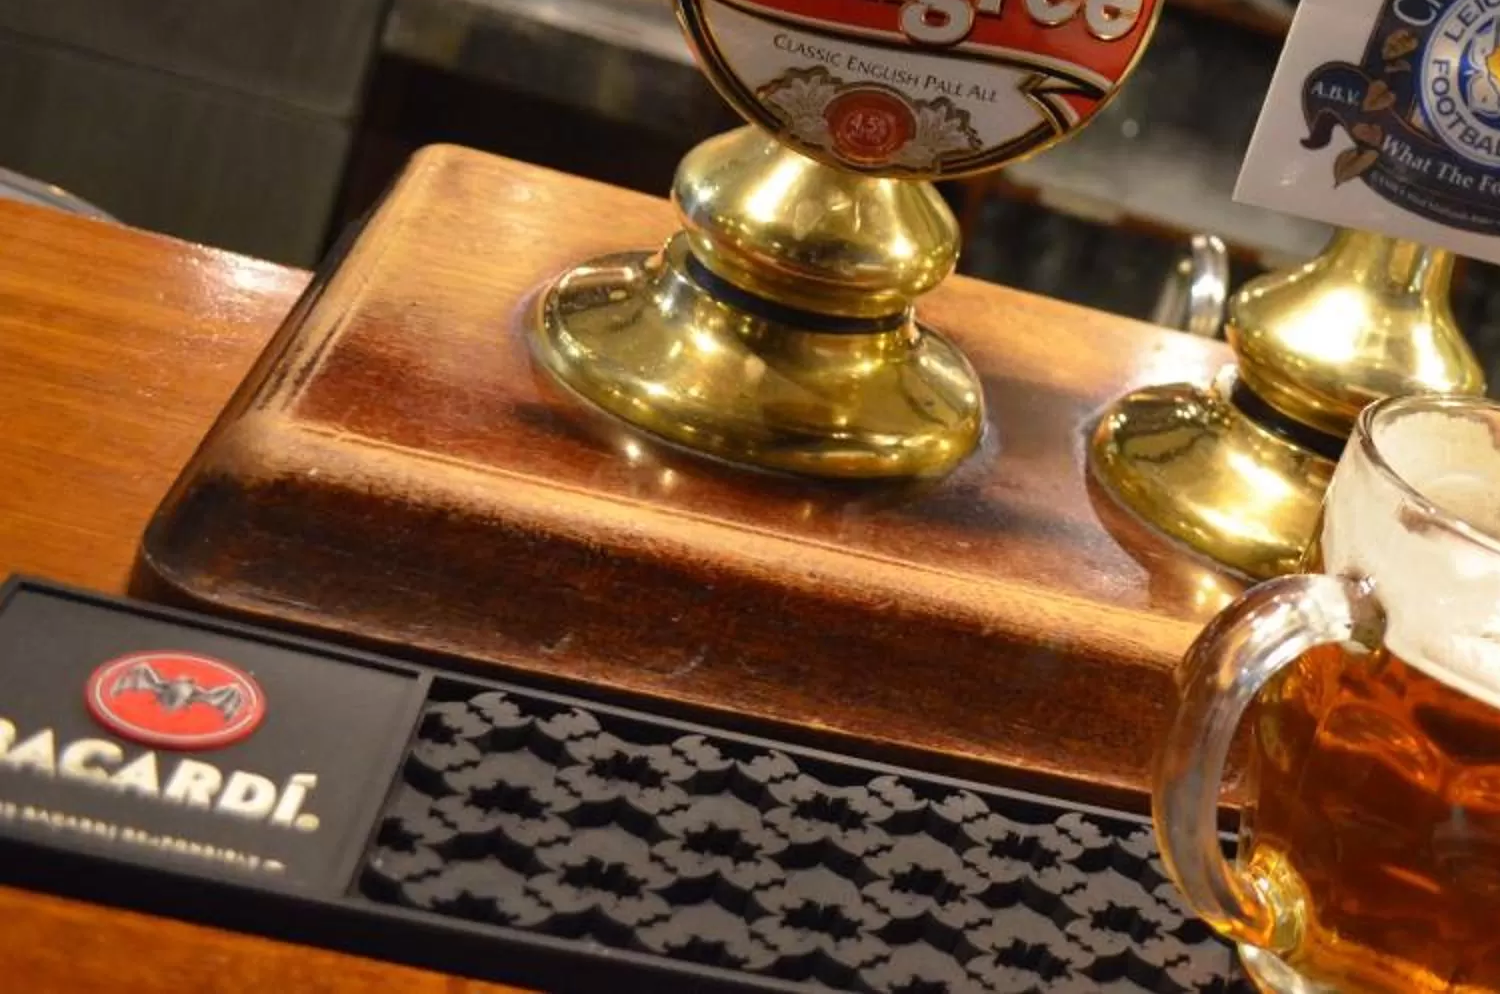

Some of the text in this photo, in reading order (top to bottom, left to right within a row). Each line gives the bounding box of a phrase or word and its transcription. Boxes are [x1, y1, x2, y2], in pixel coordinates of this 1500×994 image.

[773, 34, 841, 67] CLASSIC
[847, 57, 920, 86] ENGLISH
[1382, 134, 1432, 173] What
[1434, 161, 1474, 188] The
